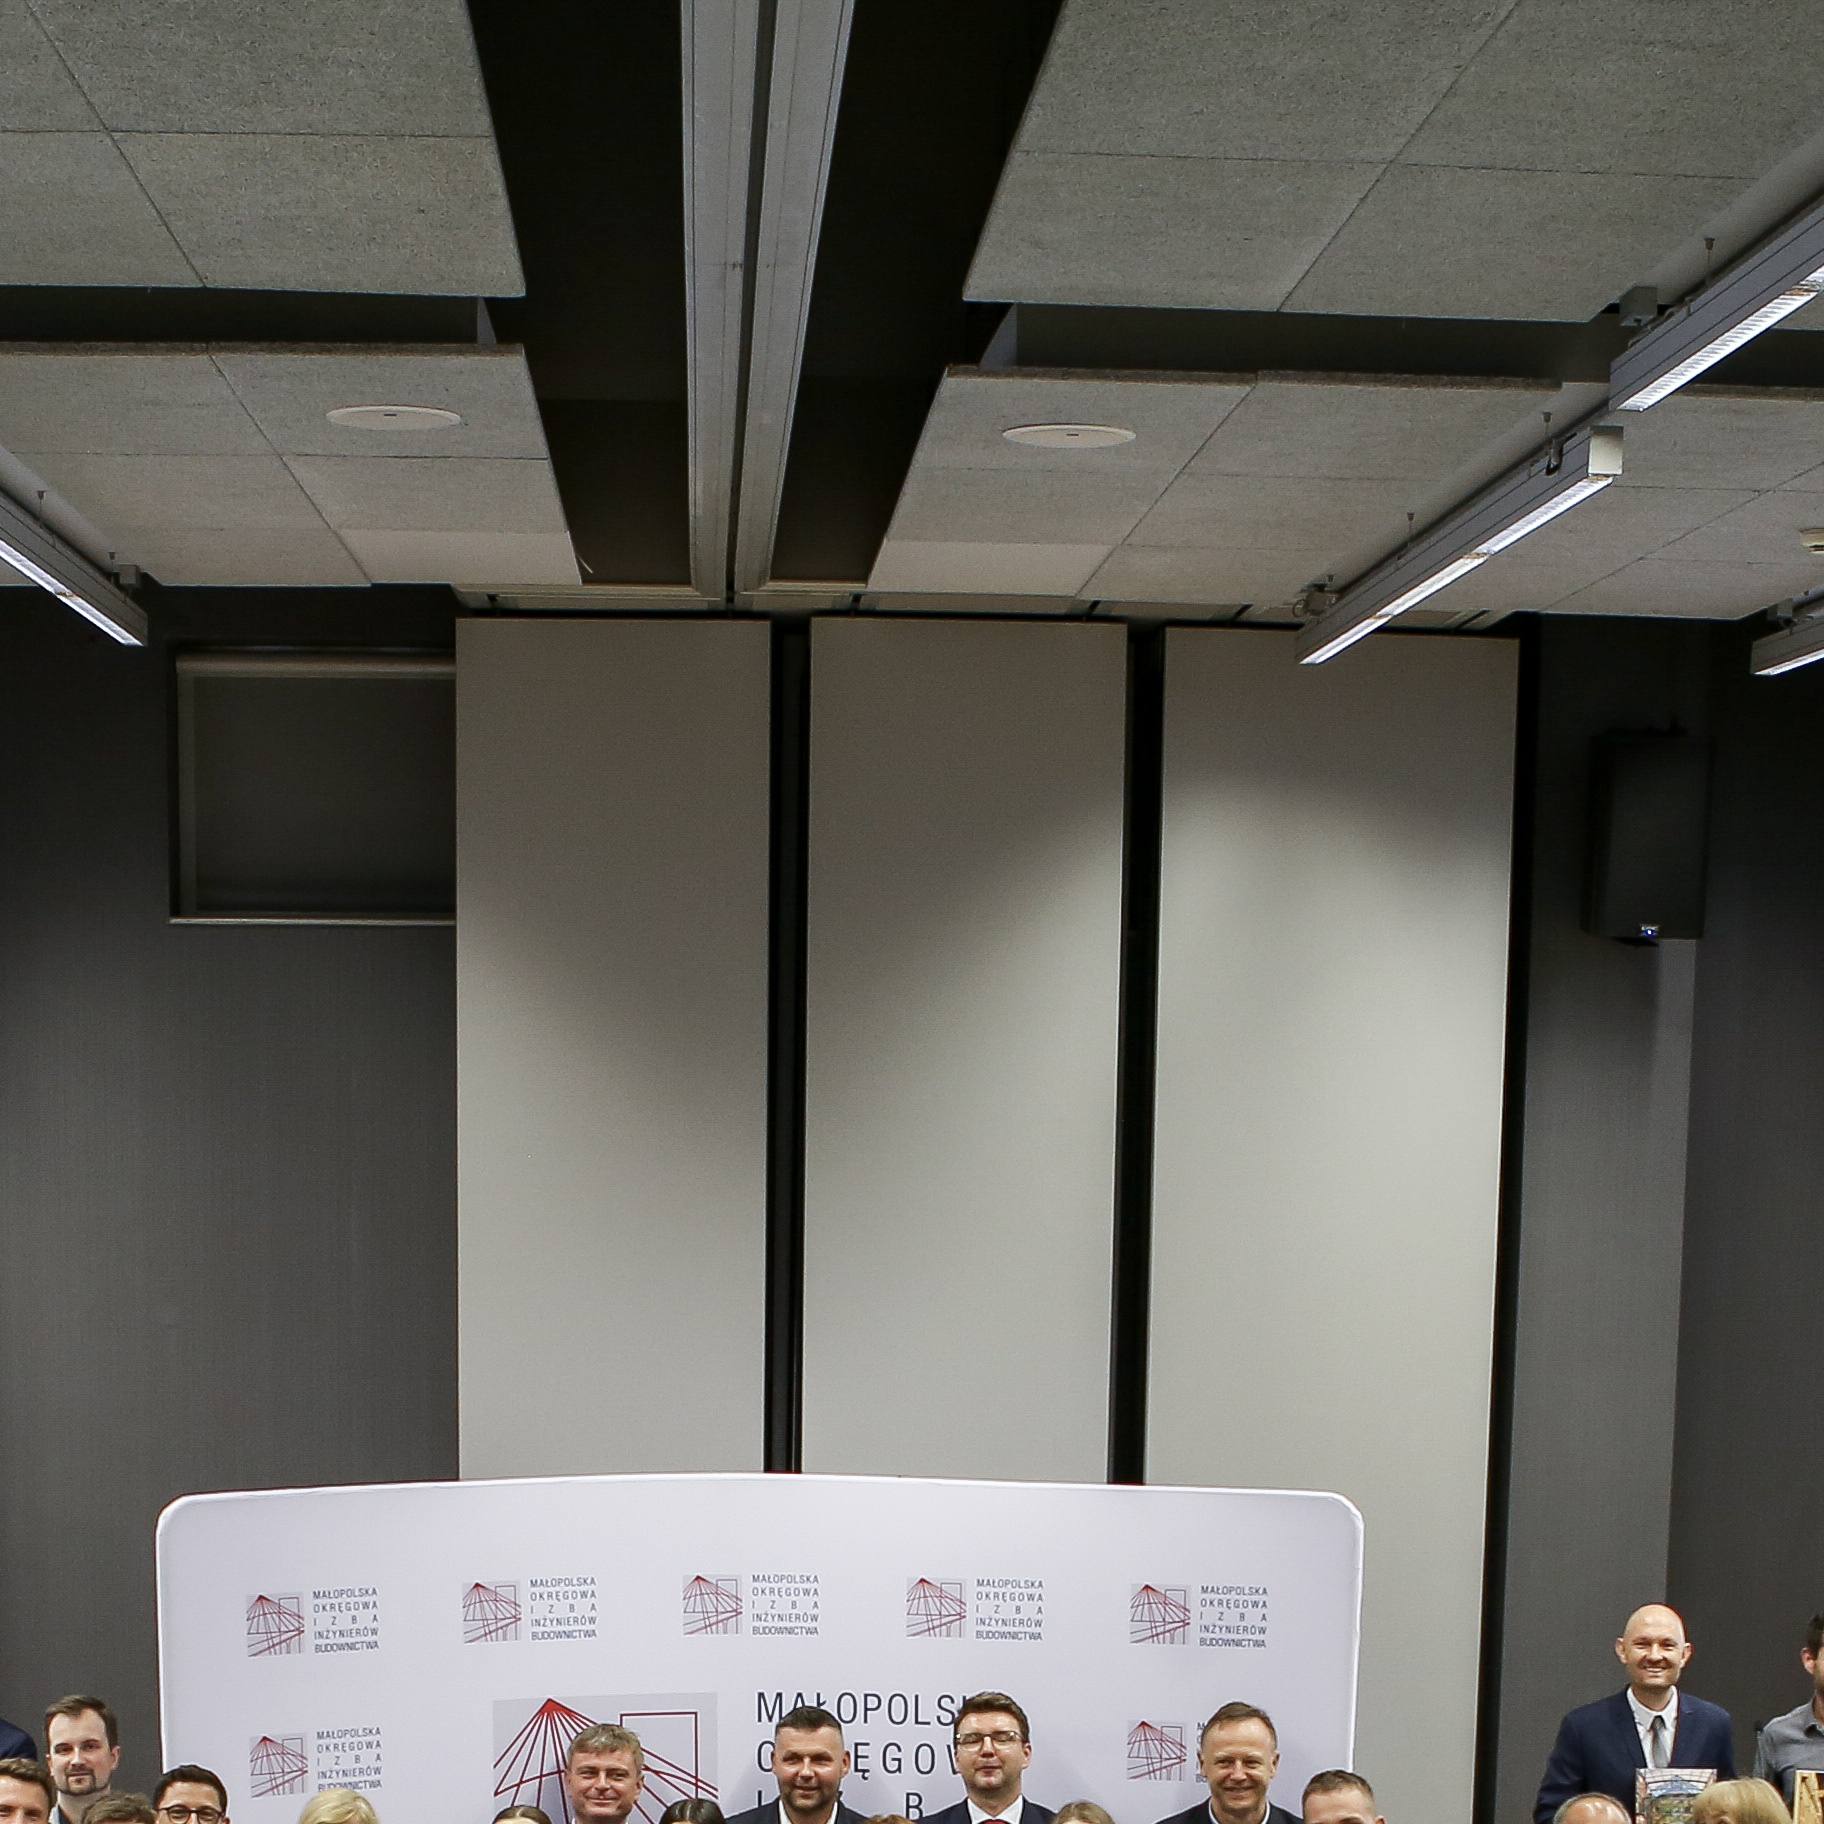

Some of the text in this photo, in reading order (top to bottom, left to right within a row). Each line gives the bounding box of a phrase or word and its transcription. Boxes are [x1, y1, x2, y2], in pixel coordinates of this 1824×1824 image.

[530, 1577, 597, 1588] MAŁOPOLSKA
[752, 1574, 819, 1585] MAŁOPOLSKA
[976, 1578, 1044, 1590] MAŁOPOLSKA
[313, 1587, 378, 1599] MAŁOPOLSKA
[530, 1590, 597, 1602] OKRĘGOWA
[752, 1587, 819, 1598] OKRĘGOWA
[1200, 1585, 1268, 1596] MAŁOPOLSKA
[976, 1591, 1044, 1603] OKRĘGOWA
[313, 1601, 379, 1614] OKRĘGOWA
[1200, 1598, 1268, 1610] OKRĘGOWA
[531, 1615, 597, 1627] INŻYNIERÓW
[752, 1611, 819, 1623] INŻYNIERÓW
[976, 1617, 1043, 1628] INŻYNIERÓW
[314, 1627, 379, 1640] INŻYNIERÓW
[531, 1629, 597, 1641] BUDOWNICTWA
[752, 1626, 819, 1636] BUDOWNICTWA
[1199, 1623, 1267, 1635] INŻYNIERÓW
[976, 1630, 1043, 1641] BUDOWNICTWA
[314, 1641, 379, 1654] BUDOWNICTWA
[1199, 1637, 1267, 1648] BUDOWNICTWA
[316, 1727, 381, 1740] MAŁOPOLSKA
[317, 1740, 381, 1753] OKRĘGOWA
[317, 1765, 382, 1780] INŻYNIERÓW
